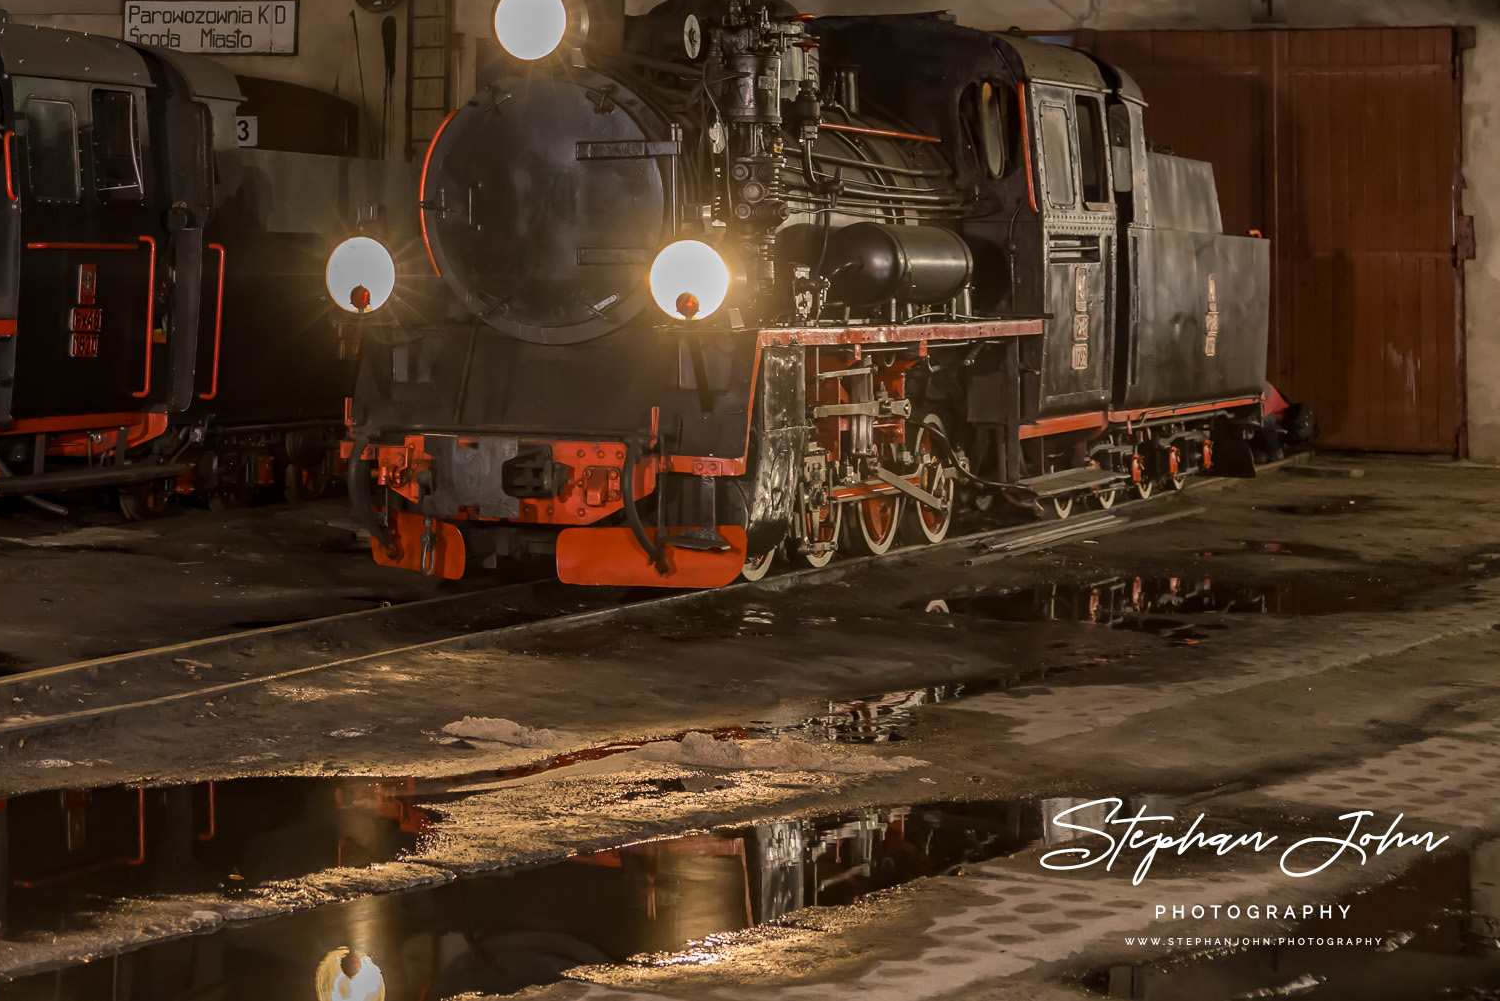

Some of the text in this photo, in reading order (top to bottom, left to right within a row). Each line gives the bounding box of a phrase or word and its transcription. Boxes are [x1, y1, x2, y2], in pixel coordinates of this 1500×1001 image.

[128, 5, 252, 24] Parowozownia
[129, 25, 252, 48] Środa Miasto
[237, 120, 249, 141] 3
